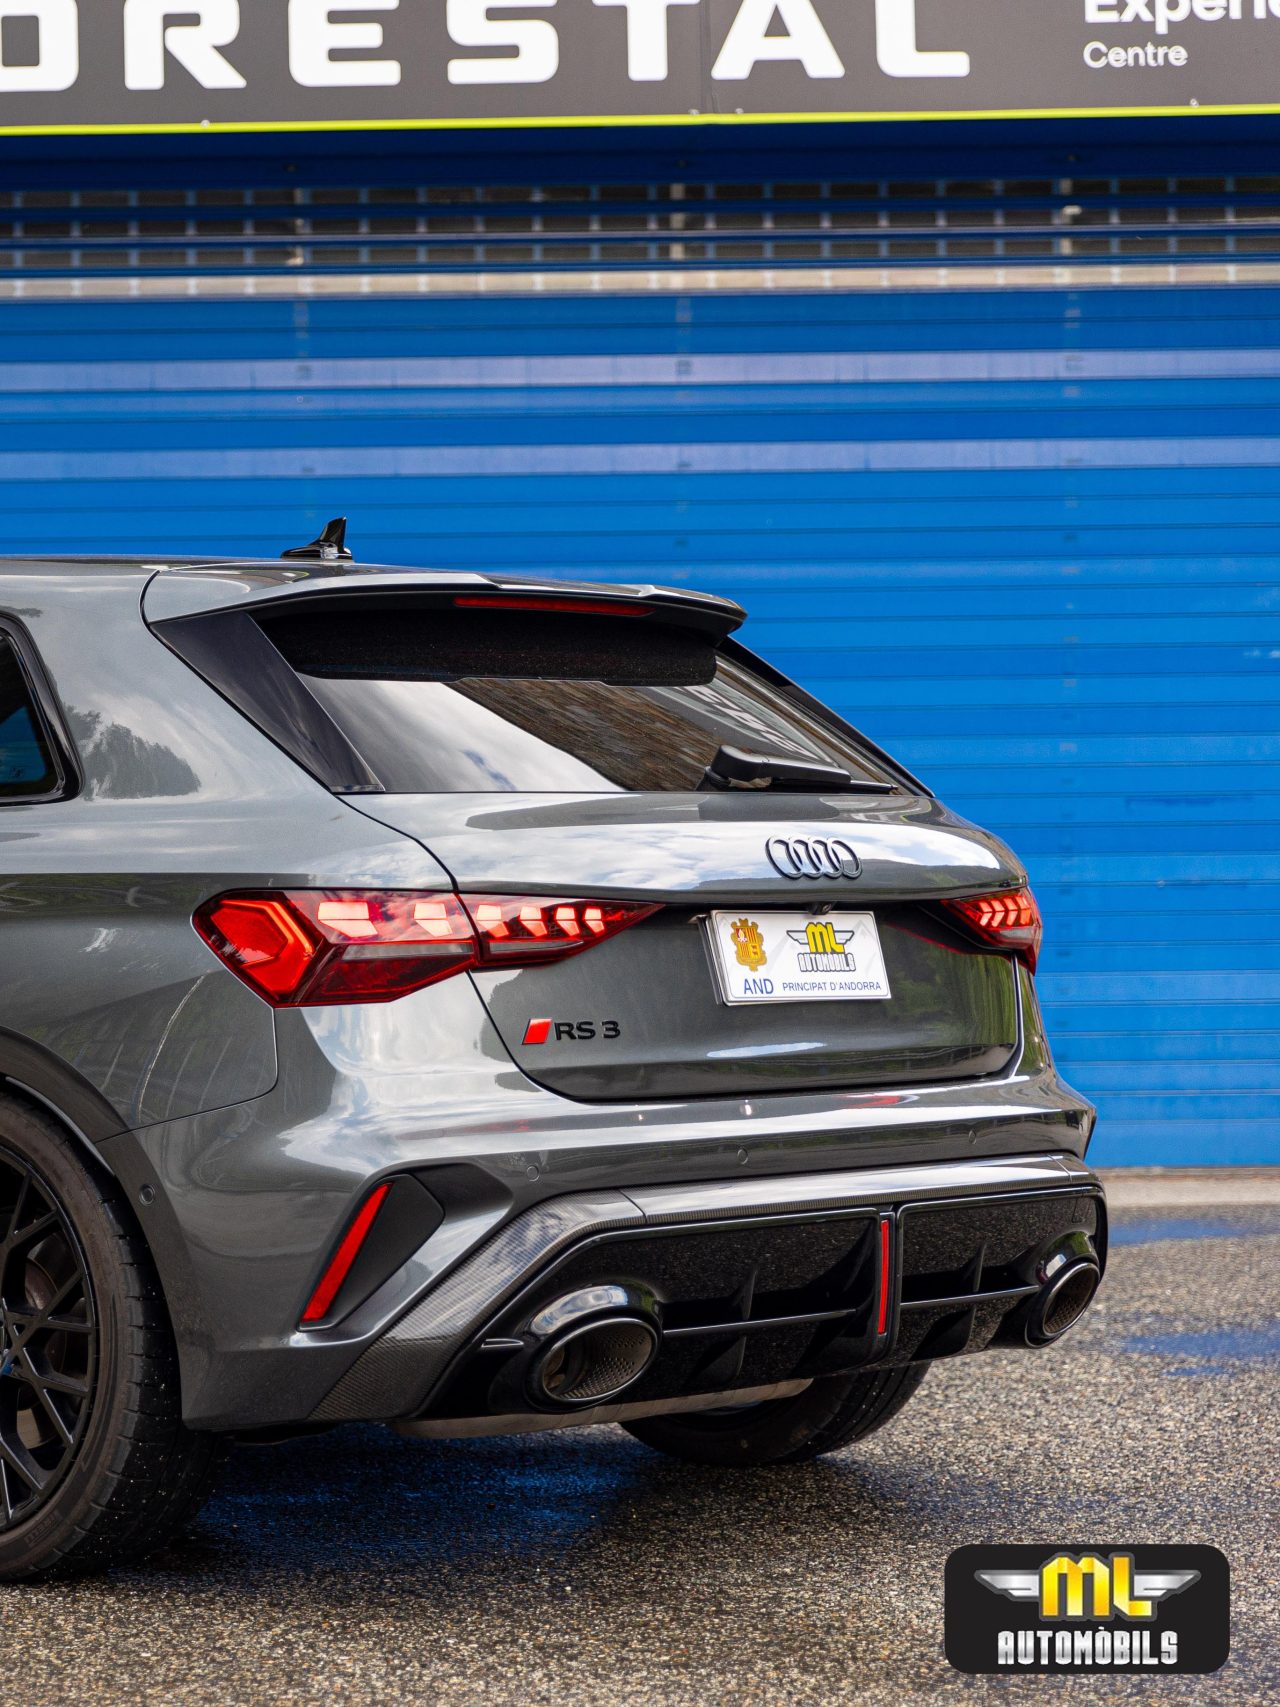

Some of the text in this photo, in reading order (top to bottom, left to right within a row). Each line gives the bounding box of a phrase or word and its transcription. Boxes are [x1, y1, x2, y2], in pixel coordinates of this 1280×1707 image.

[1083, 41, 1189, 68] Centre
[743, 978, 882, 995] AND PRINCIPAT D'ANDORRA
[554, 1020, 621, 1040] RS 3
